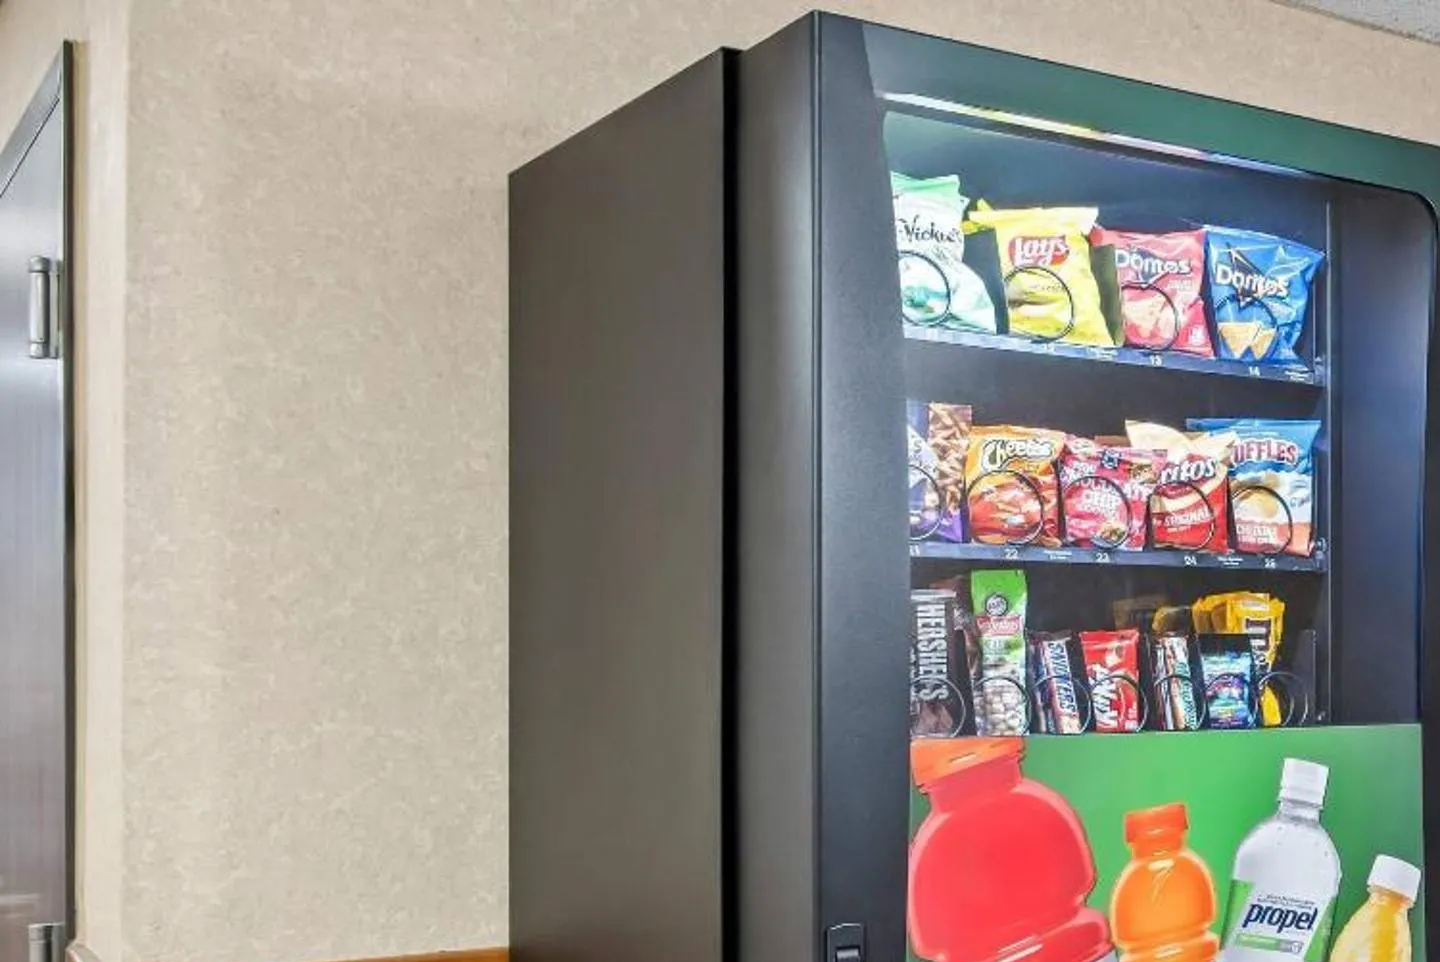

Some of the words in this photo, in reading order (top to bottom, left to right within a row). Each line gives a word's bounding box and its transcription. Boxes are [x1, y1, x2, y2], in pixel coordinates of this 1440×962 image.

[1115, 248, 1192, 275] Doritos
[1216, 262, 1291, 298] Doritos
[1230, 438, 1299, 467] UFFLES
[1159, 459, 1217, 484] ritos
[1242, 904, 1318, 933] propel
